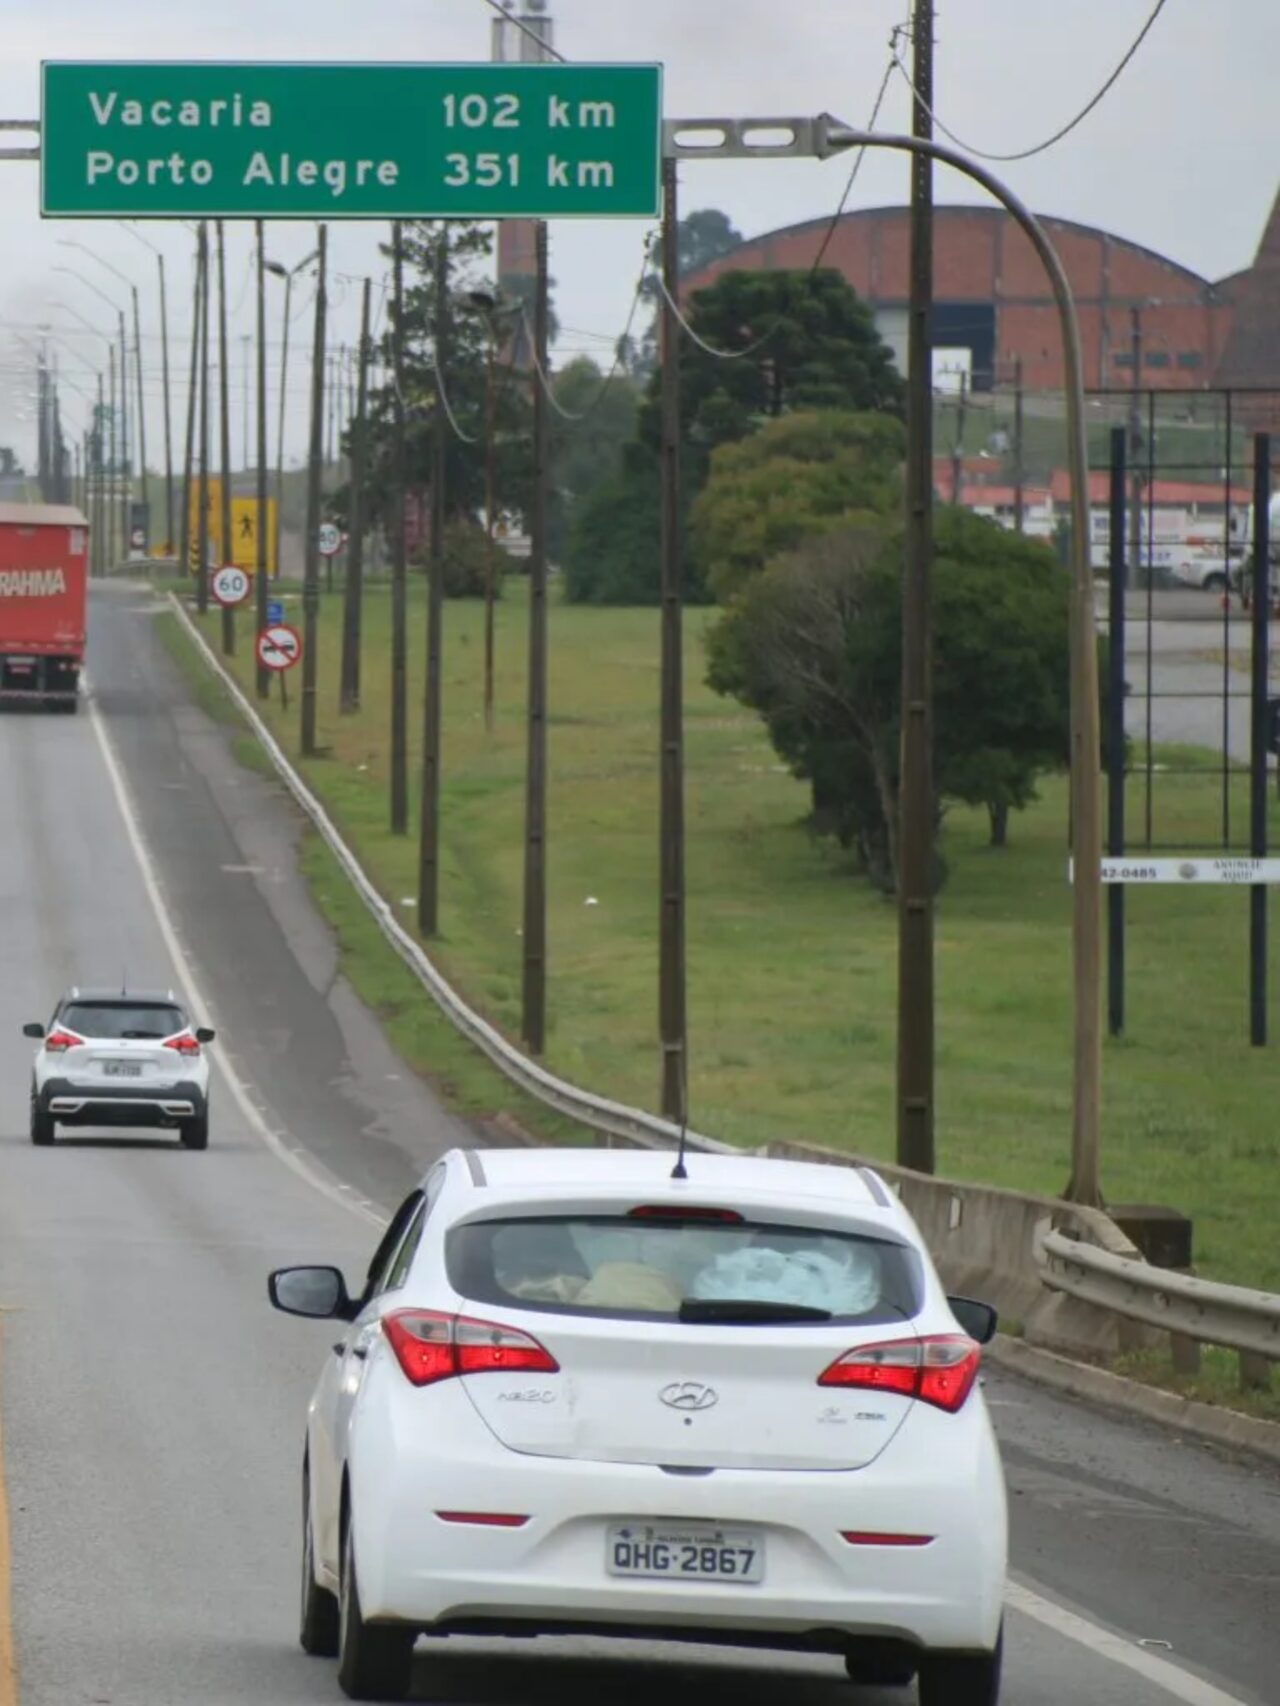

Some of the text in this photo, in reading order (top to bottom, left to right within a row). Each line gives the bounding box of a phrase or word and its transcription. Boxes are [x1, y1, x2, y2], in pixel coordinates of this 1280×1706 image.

[88, 92, 615, 128] Vacaria 102 km
[87, 151, 614, 196] Porto Alegre 351 km
[219, 575, 244, 592] 60
